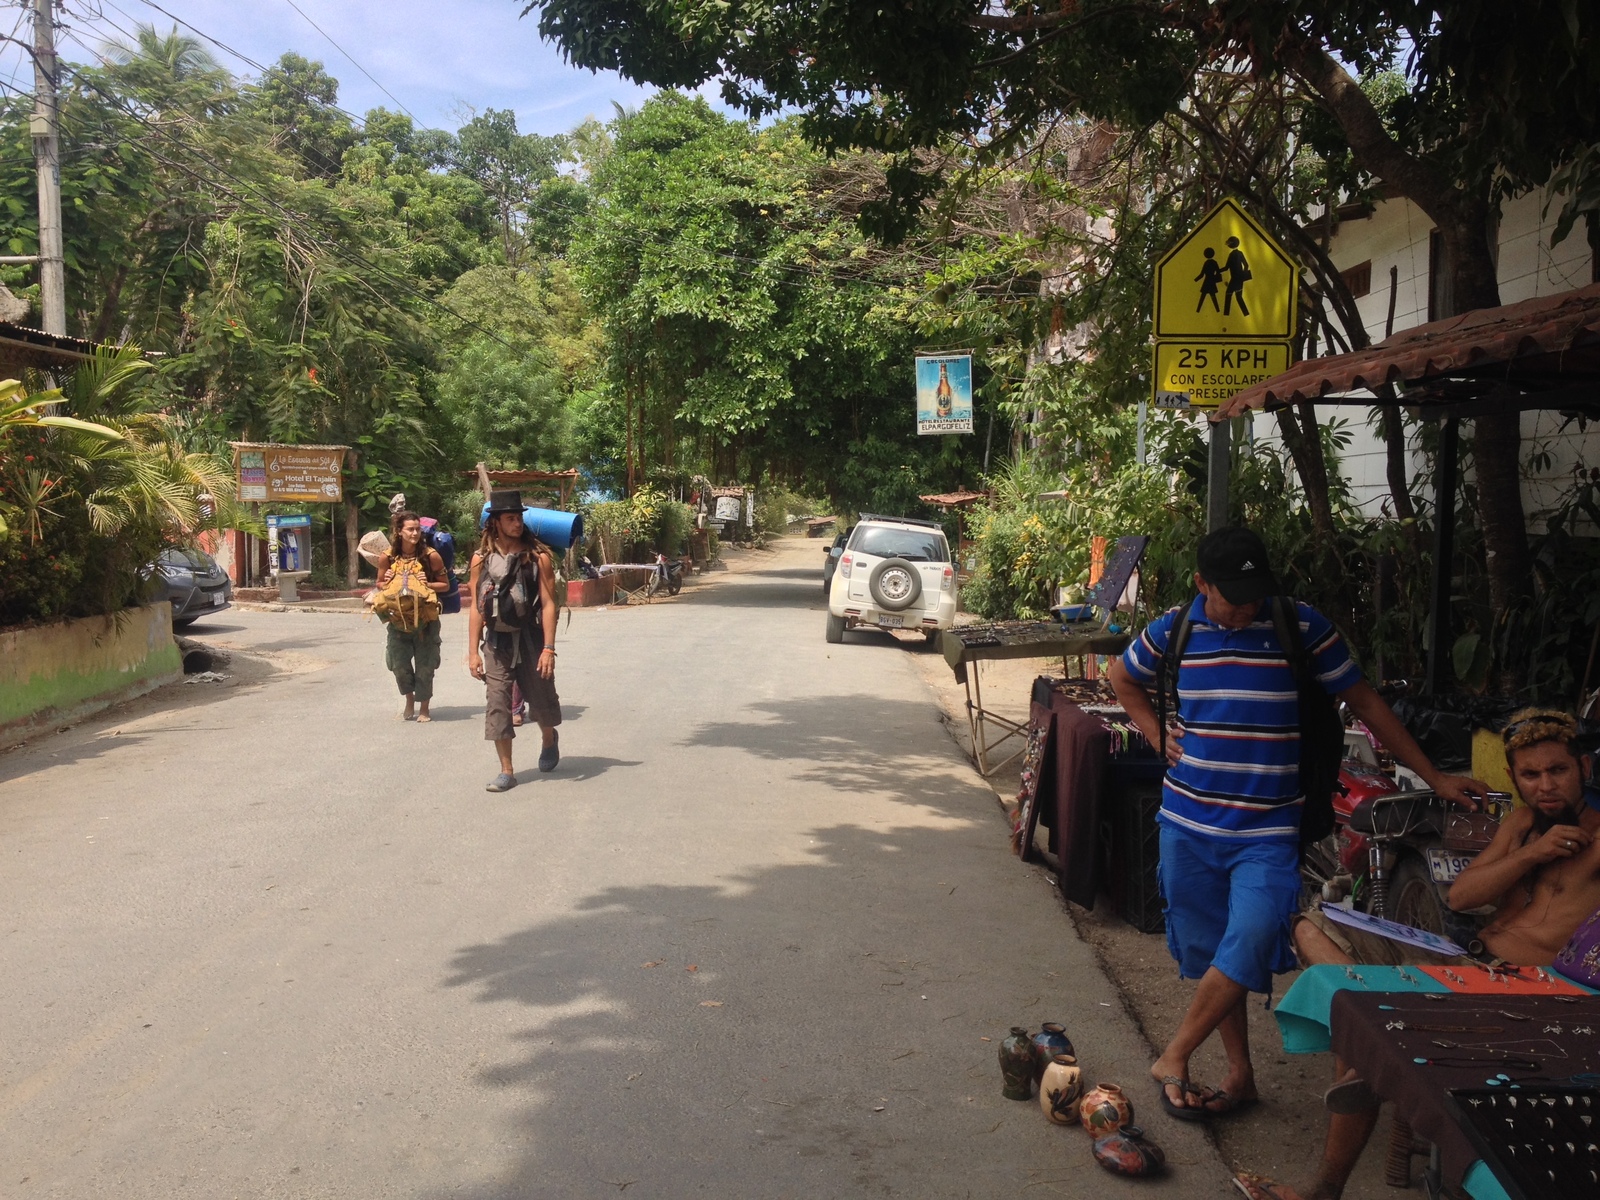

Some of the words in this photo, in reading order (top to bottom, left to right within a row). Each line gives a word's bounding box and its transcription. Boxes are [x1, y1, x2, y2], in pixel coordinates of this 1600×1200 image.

[1178, 348, 1208, 369] 25
[1221, 349, 1268, 369] KPH
[1170, 374, 1195, 385] CON
[1188, 388, 1243, 399] PRESENT
[950, 422, 971, 430] FELIZ
[287, 455, 311, 464] Escuela
[1433, 861, 1441, 869] M
